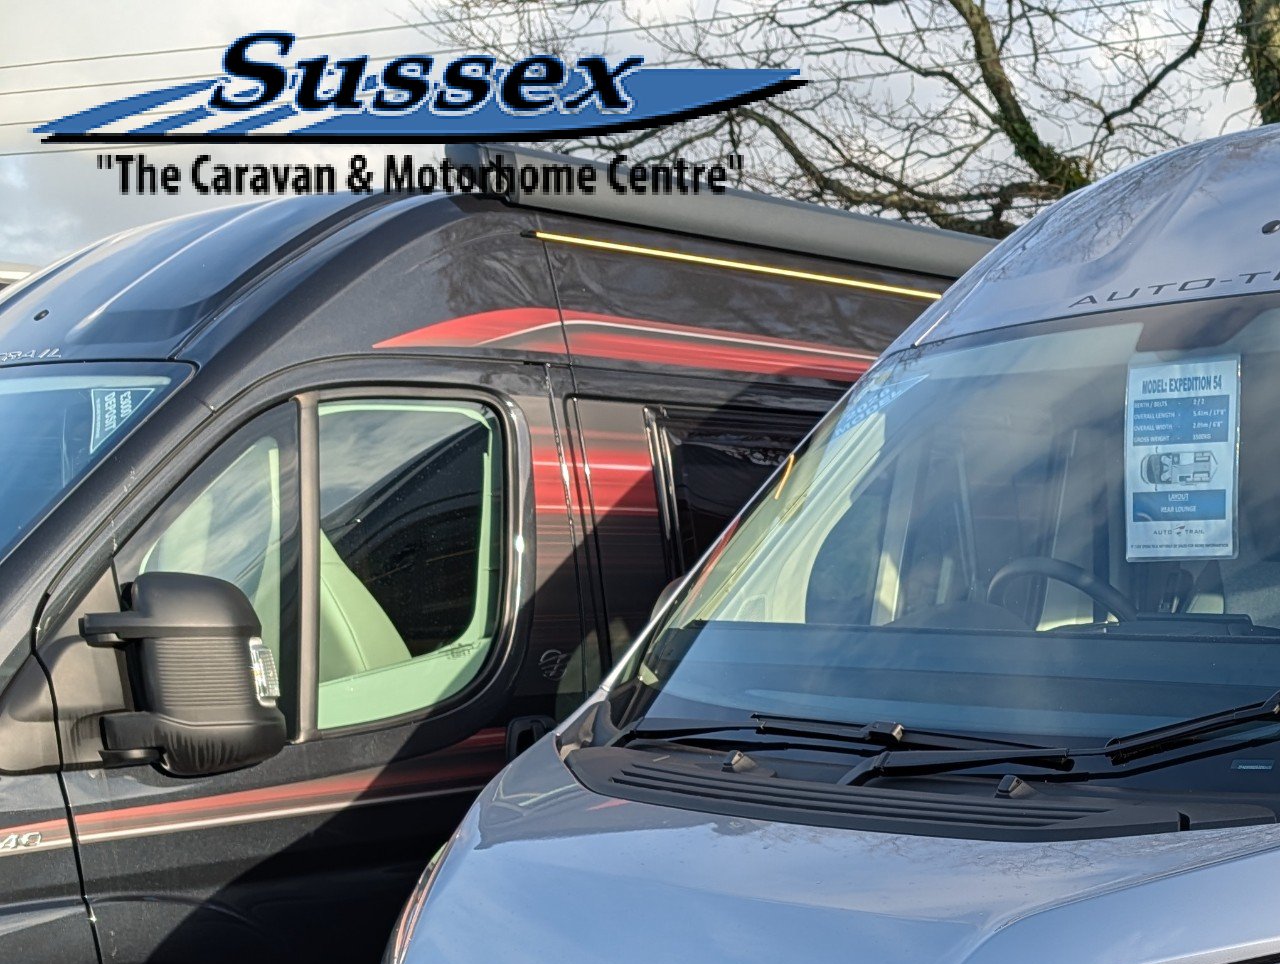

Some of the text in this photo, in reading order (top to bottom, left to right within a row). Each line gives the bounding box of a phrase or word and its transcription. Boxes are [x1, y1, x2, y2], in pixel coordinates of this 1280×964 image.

[1142, 374, 1223, 395] MODEL: EXPEDITION 54
[104, 391, 117, 432] DEPOSIT
